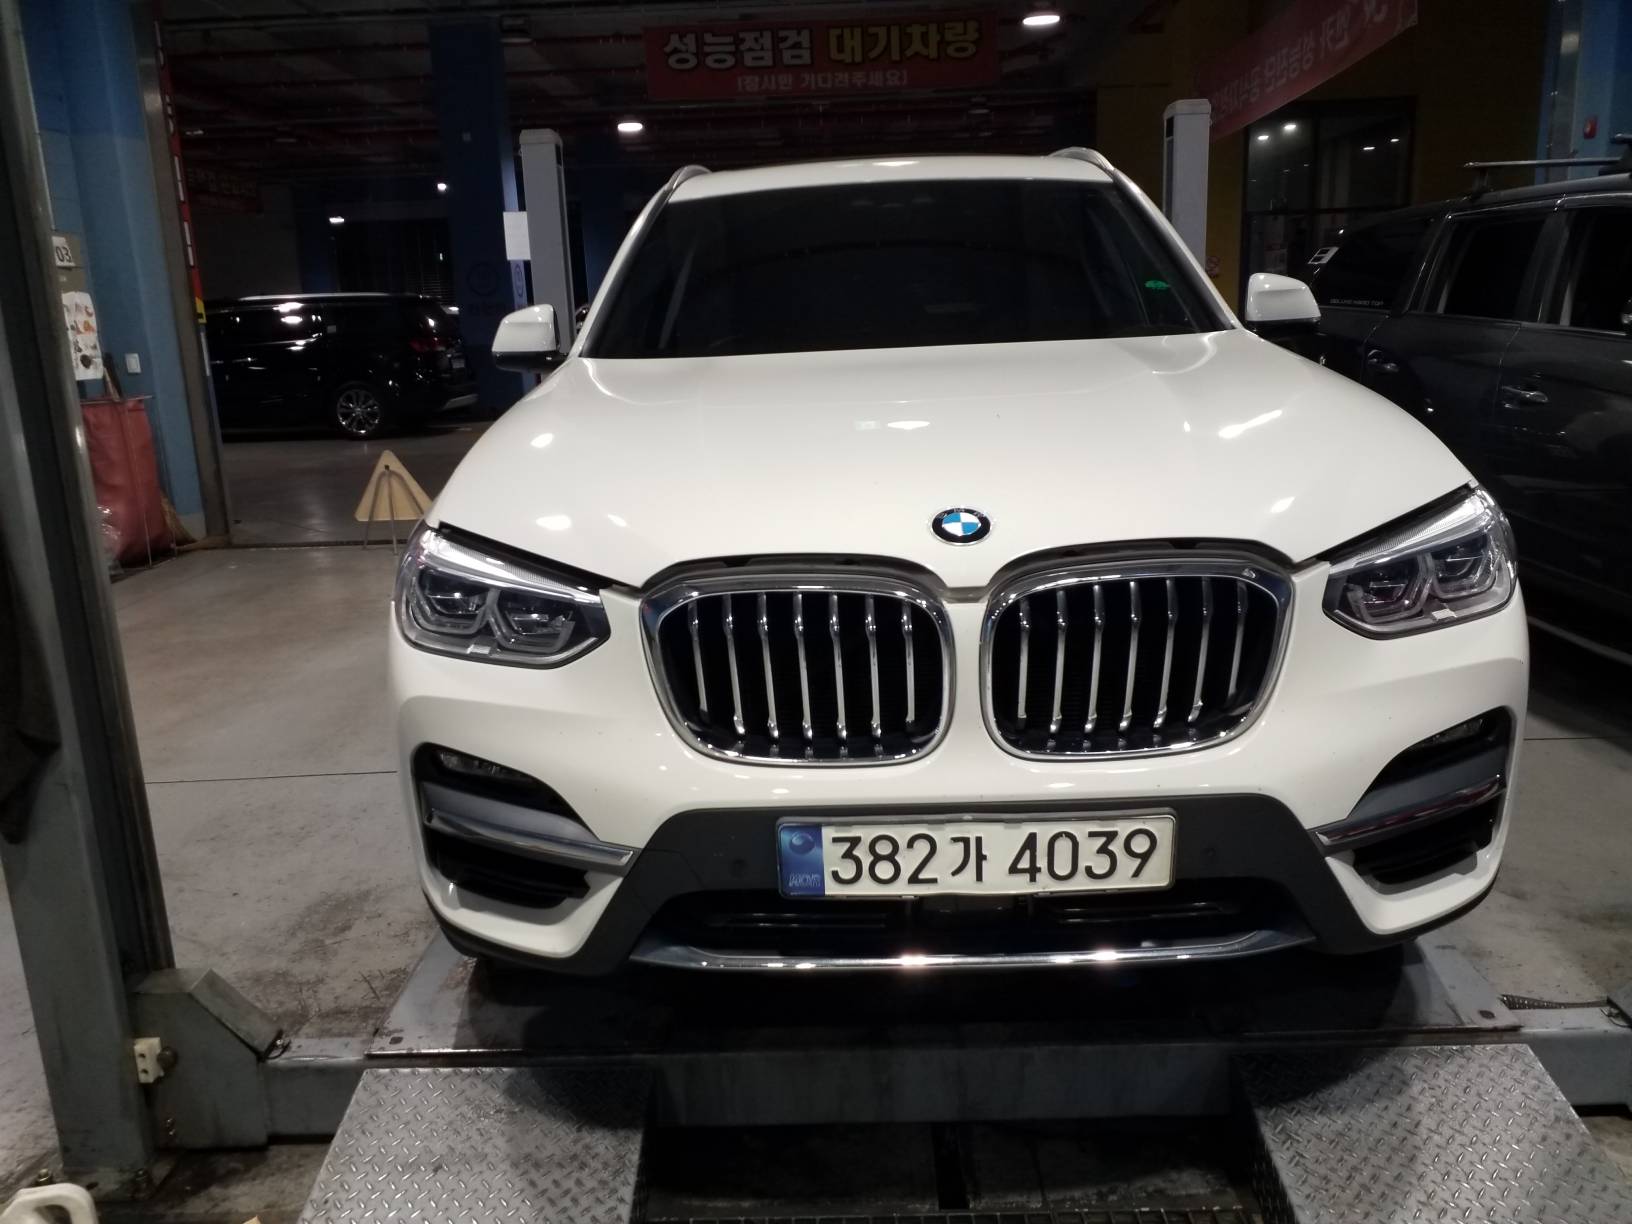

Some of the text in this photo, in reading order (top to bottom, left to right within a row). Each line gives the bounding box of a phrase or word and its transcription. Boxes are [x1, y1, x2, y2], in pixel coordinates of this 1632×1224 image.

[664, 20, 979, 70] 성능점검 대기차량
[830, 827, 1158, 885] 382가 4039
